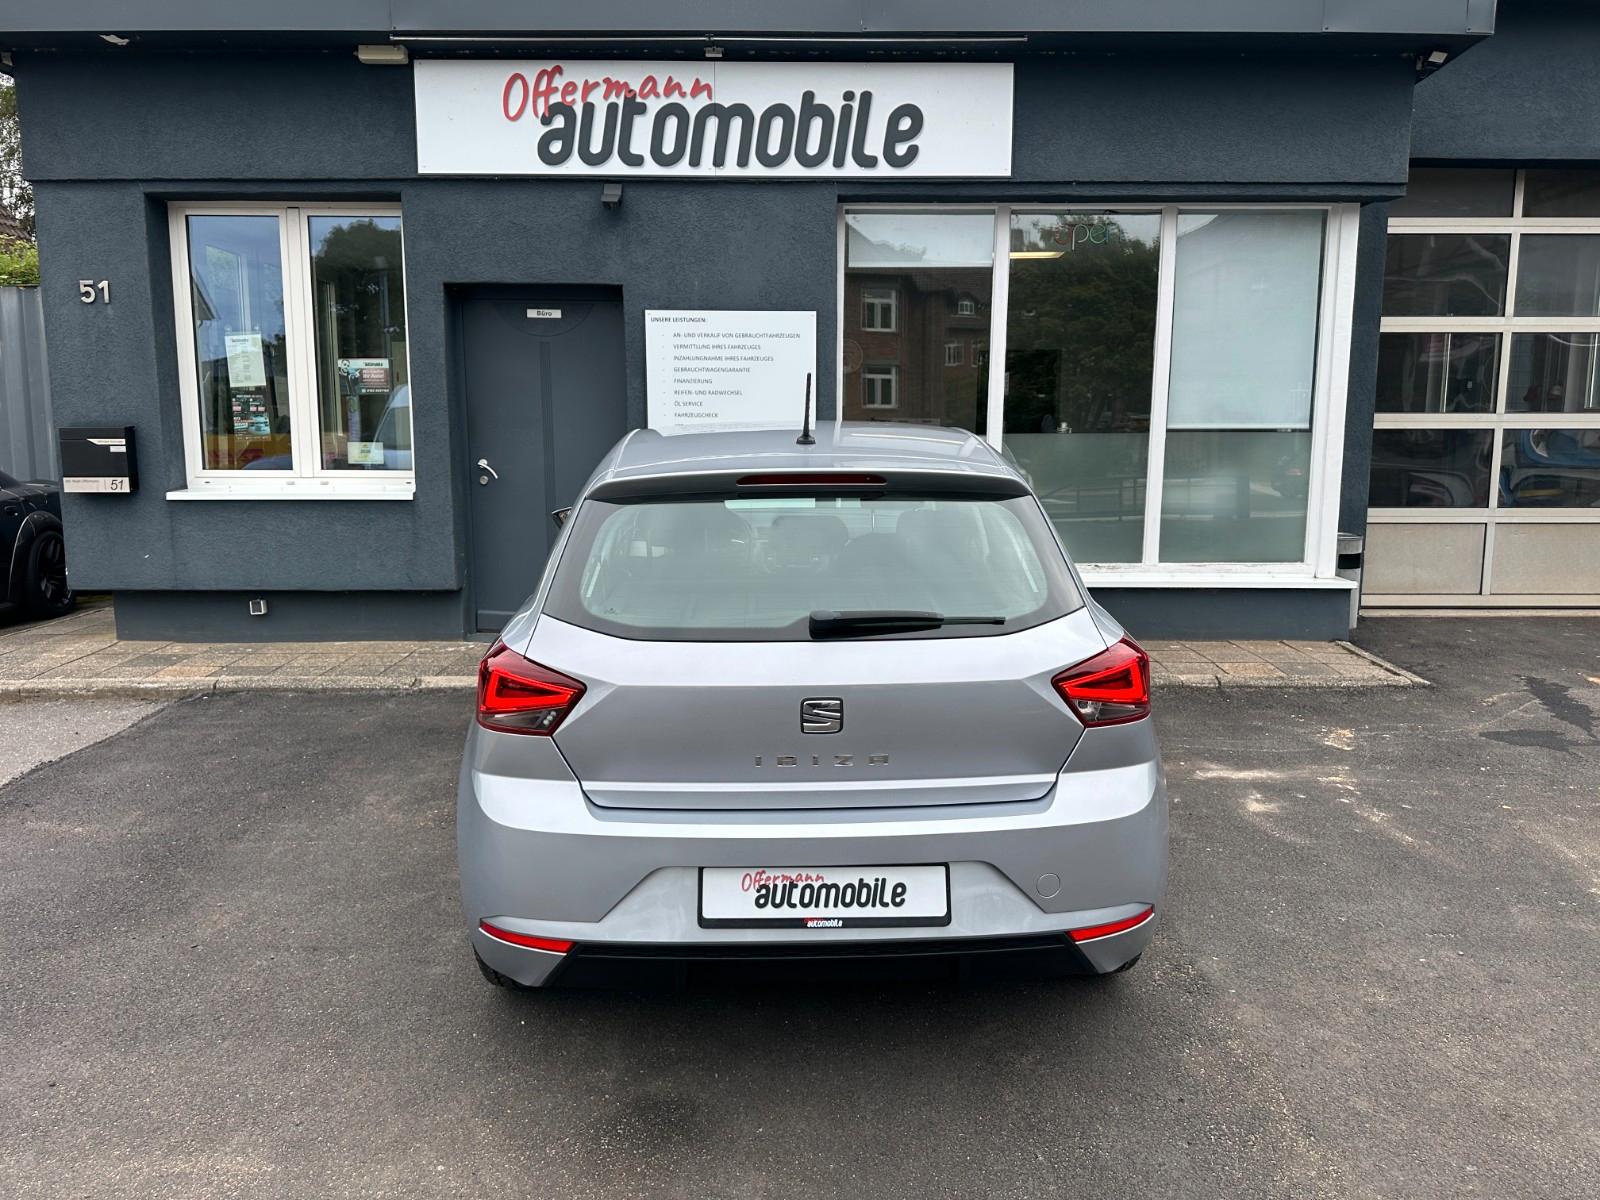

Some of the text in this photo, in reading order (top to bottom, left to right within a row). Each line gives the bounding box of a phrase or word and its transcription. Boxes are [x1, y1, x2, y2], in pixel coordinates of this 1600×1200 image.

[502, 65, 714, 122] Offermann
[537, 89, 924, 169] automobile
[79, 279, 110, 304] 51
[110, 479, 124, 491] 51
[754, 753, 890, 768] IBIZA
[741, 870, 825, 892] Offermann
[754, 877, 907, 909] automobile
[806, 918, 843, 928] automobile
